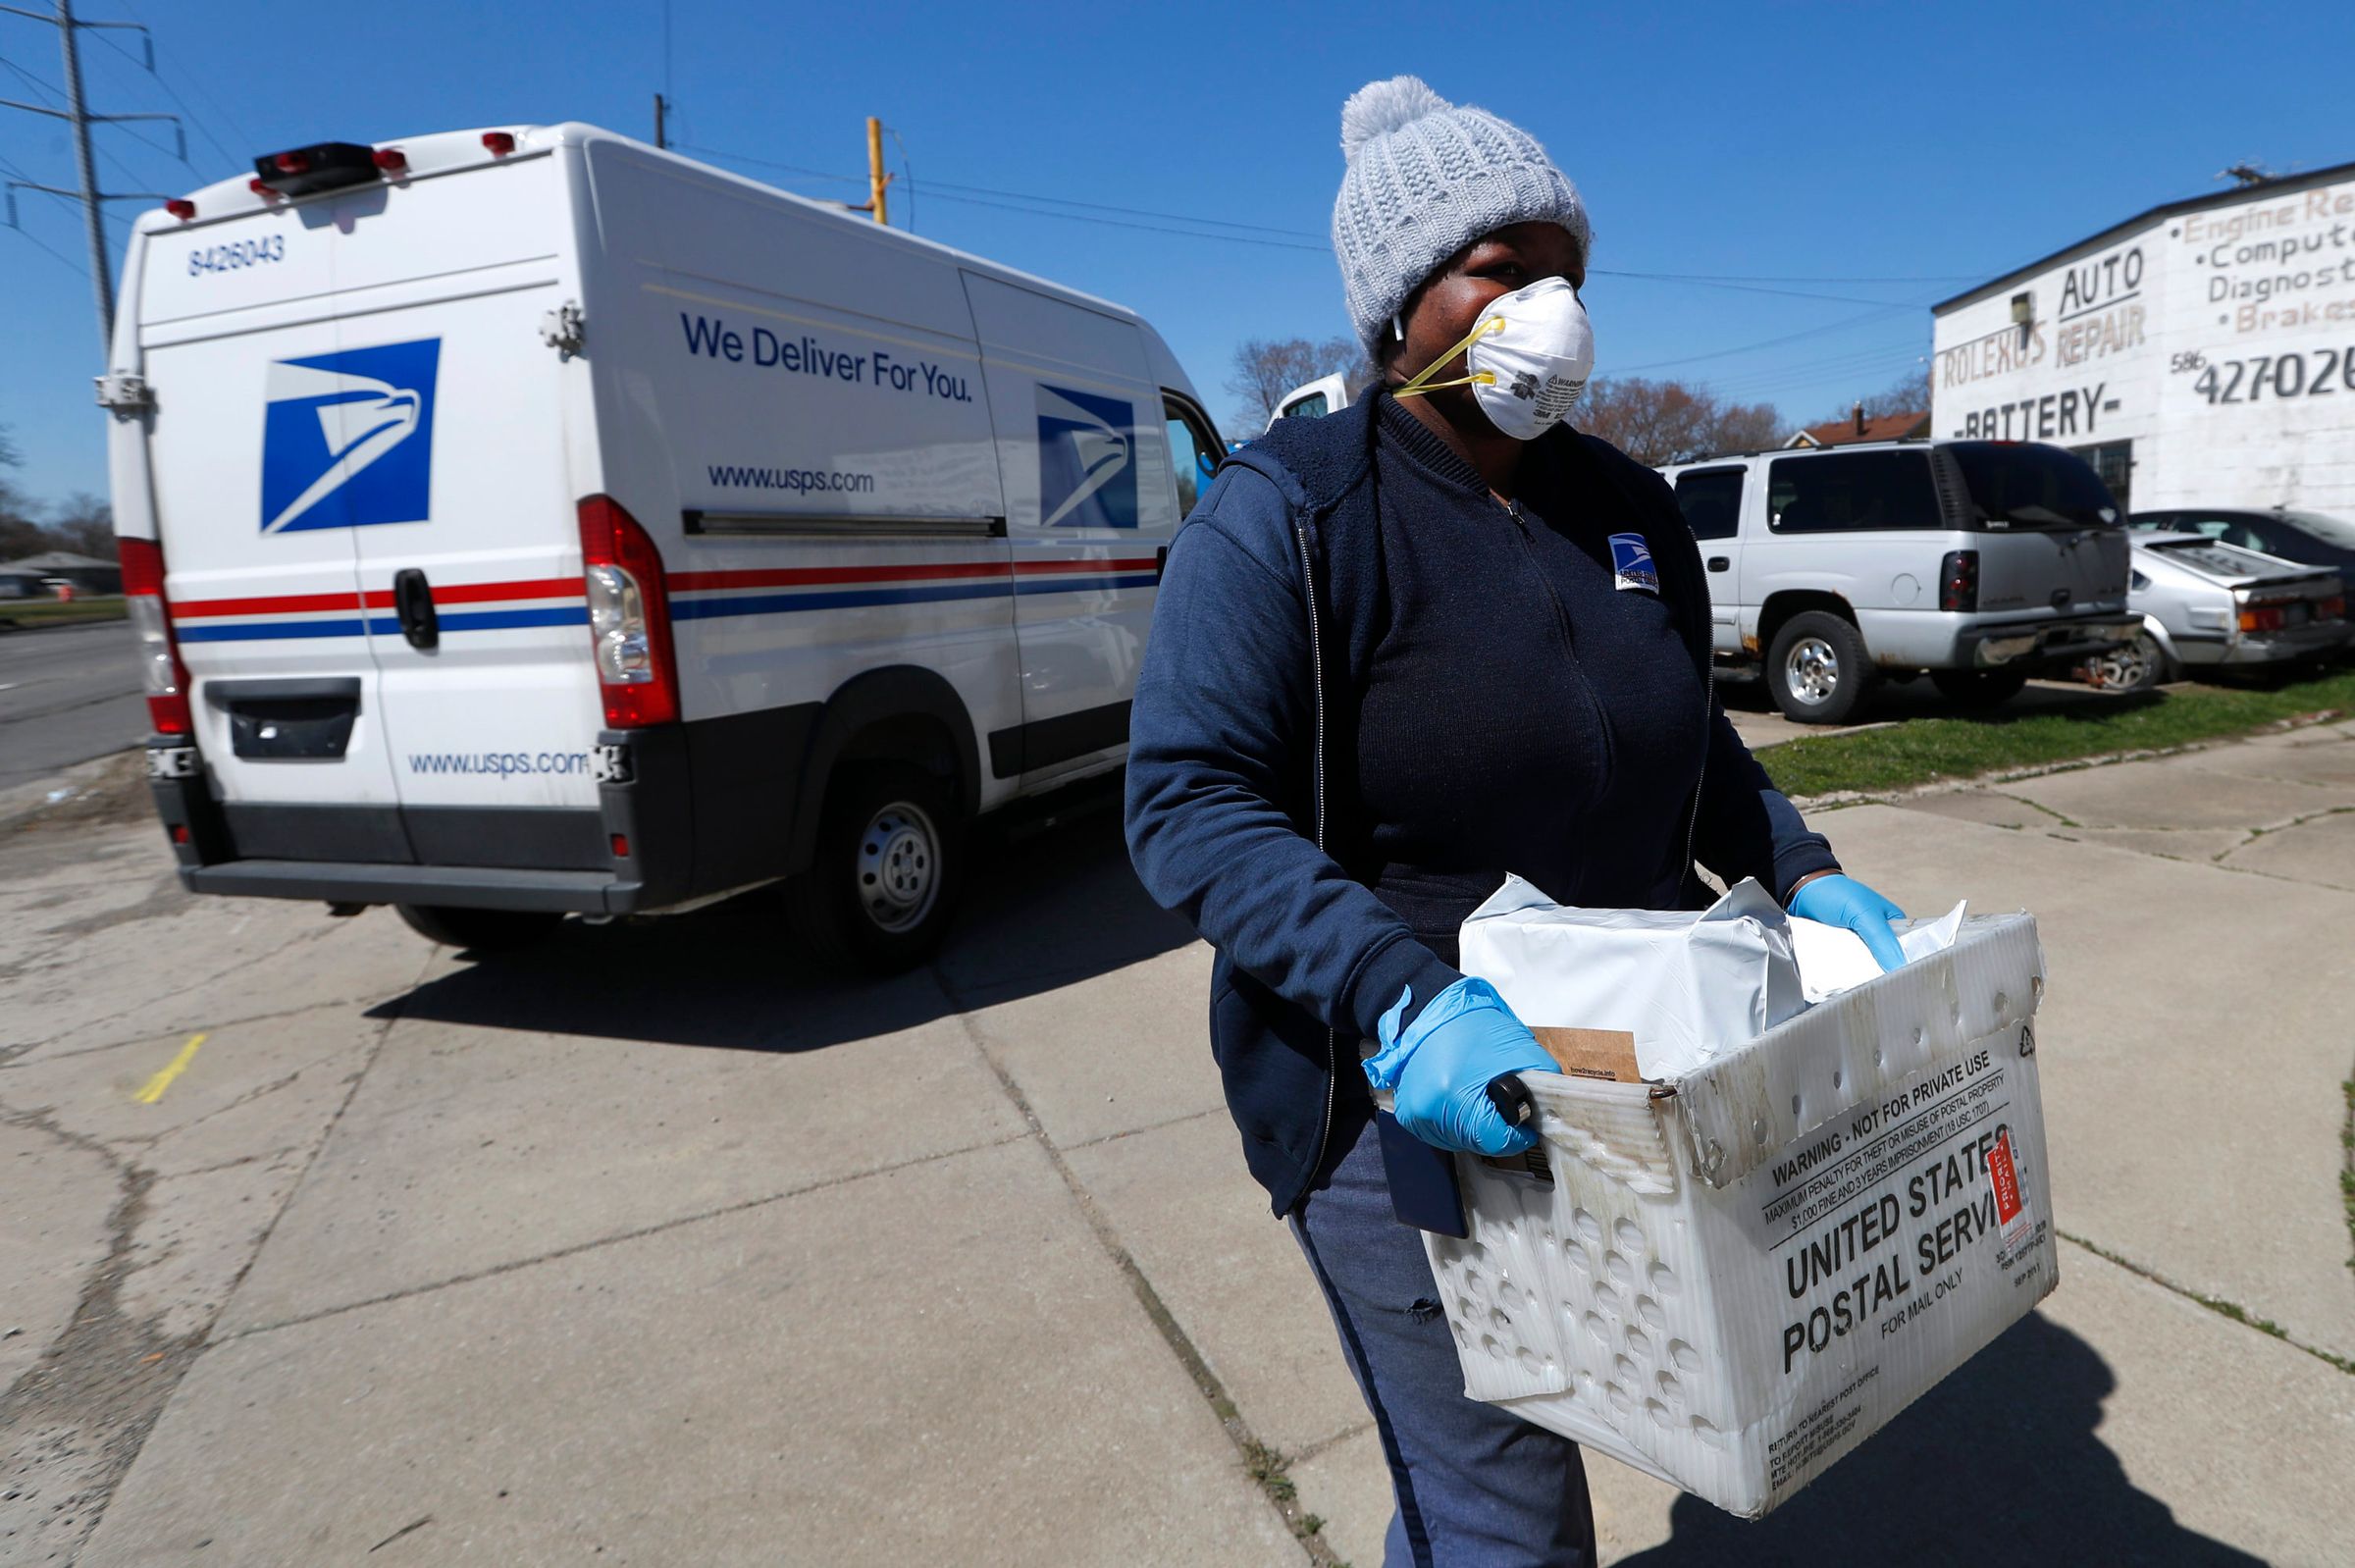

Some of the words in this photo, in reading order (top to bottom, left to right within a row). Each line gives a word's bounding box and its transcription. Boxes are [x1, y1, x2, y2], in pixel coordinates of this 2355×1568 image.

[187, 234, 285, 278] 8426043
[2183, 205, 2295, 243] Engine
[2211, 223, 2355, 268] Comput
[2059, 247, 2143, 316] AUTO
[680, 312, 743, 362] We
[753, 327, 865, 383] Deliver
[873, 351, 916, 392] For
[920, 361, 972, 403] You.
[1944, 320, 2047, 389] ROLEXUS
[2056, 305, 2146, 369] REPAIR
[2171, 350, 2206, 374] 586
[707, 465, 874, 497] www.usps.com
[1764, 1189, 1807, 1225] MAXIMUM
[1808, 1166, 1844, 1198] PENALTY
[1845, 1156, 1862, 1176] FOR
[1862, 1140, 1887, 1165] THEFT
[1888, 1133, 1900, 1150] OR
[1900, 1119, 1929, 1140] MISUSE
[1929, 1110, 1940, 1124] OF
[1941, 1097, 1968, 1118] POSTAL
[1968, 1073, 2005, 1103] PROPERTY
[1772, 1132, 1842, 1187] WARNING
[1852, 1110, 1879, 1140] NOT
[1882, 1094, 1910, 1124] FOR
[1912, 1065, 1963, 1106] PRIVATE
[1965, 1050, 1990, 1076] USE
[1792, 1204, 1818, 1230] $1,000
[1818, 1191, 1838, 1213] FINE
[1838, 1180, 1856, 1199] AND
[1856, 1178, 1861, 1189] 3
[1860, 1161, 1888, 1185] YEARS
[1888, 1124, 1945, 1170] IMPRISONMENT
[1945, 1121, 1956, 1137] (18
[1956, 1110, 1971, 1128] USC
[1972, 1100, 1990, 1119] 1707)
[1787, 1193, 1900, 1300] UNITED
[1784, 1254, 1910, 1375] POSTAL
[1881, 1310, 1907, 1339] FOR
[1908, 1294, 1932, 1321] MAIL
[1935, 1268, 1962, 1300] ONLY
[1768, 1428, 1798, 1454] RETURN
[1798, 1420, 1807, 1431] TO
[1808, 1395, 1839, 1425] NEAREST
[1840, 1383, 1856, 1403] POST
[1769, 1456, 1781, 1468] TO
